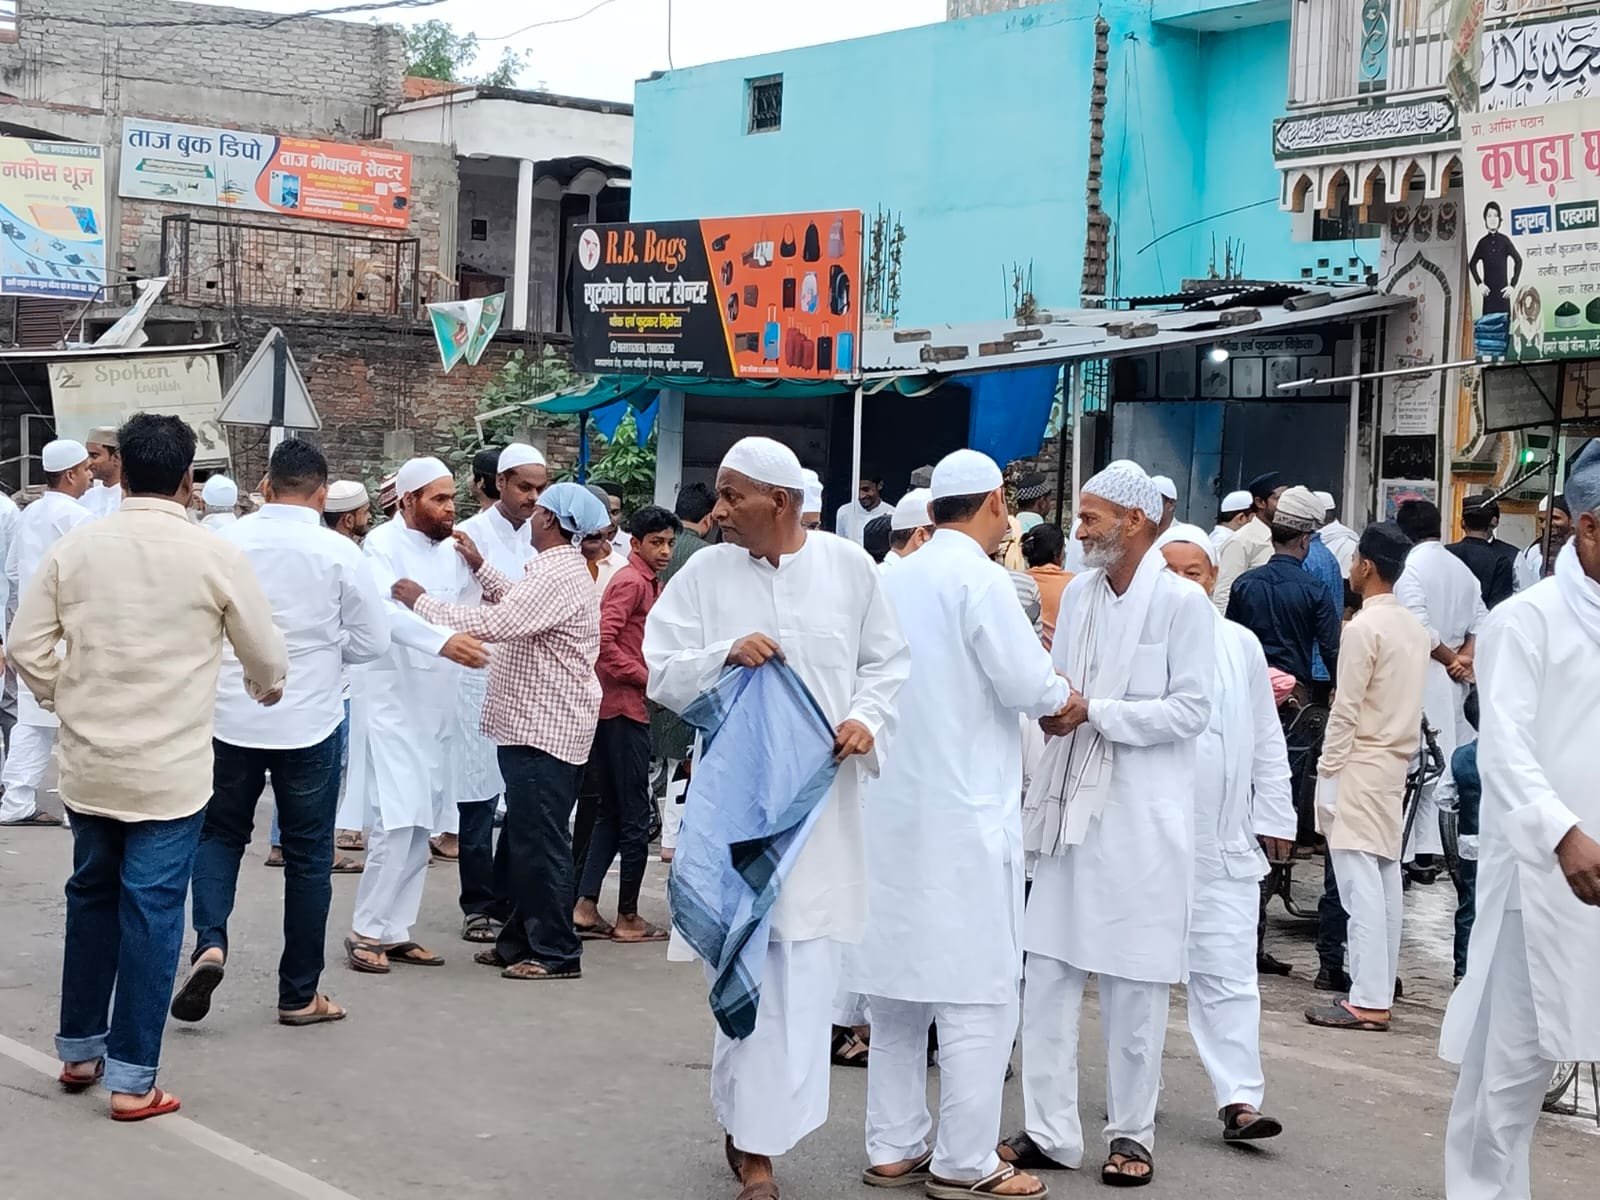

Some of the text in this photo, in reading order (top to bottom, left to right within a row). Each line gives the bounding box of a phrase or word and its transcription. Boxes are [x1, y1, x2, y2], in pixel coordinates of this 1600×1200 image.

[1489, 118, 1517, 134] आमिर
[1520, 116, 1544, 129] पठान
[128, 128, 263, 160] ताज बुक डिपो
[0, 157, 94, 191] नफीस शूज
[280, 150, 309, 168] ताज
[311, 153, 362, 175] मोबाइल
[1477, 133, 1574, 198] कपड़ा
[1560, 207, 1597, 227] एहराम
[605, 229, 687, 272] R.B. Bags
[626, 276, 645, 304] बैग
[648, 275, 671, 304] बेल्ट
[95, 363, 170, 386] Spoken
[136, 382, 181, 395] English
